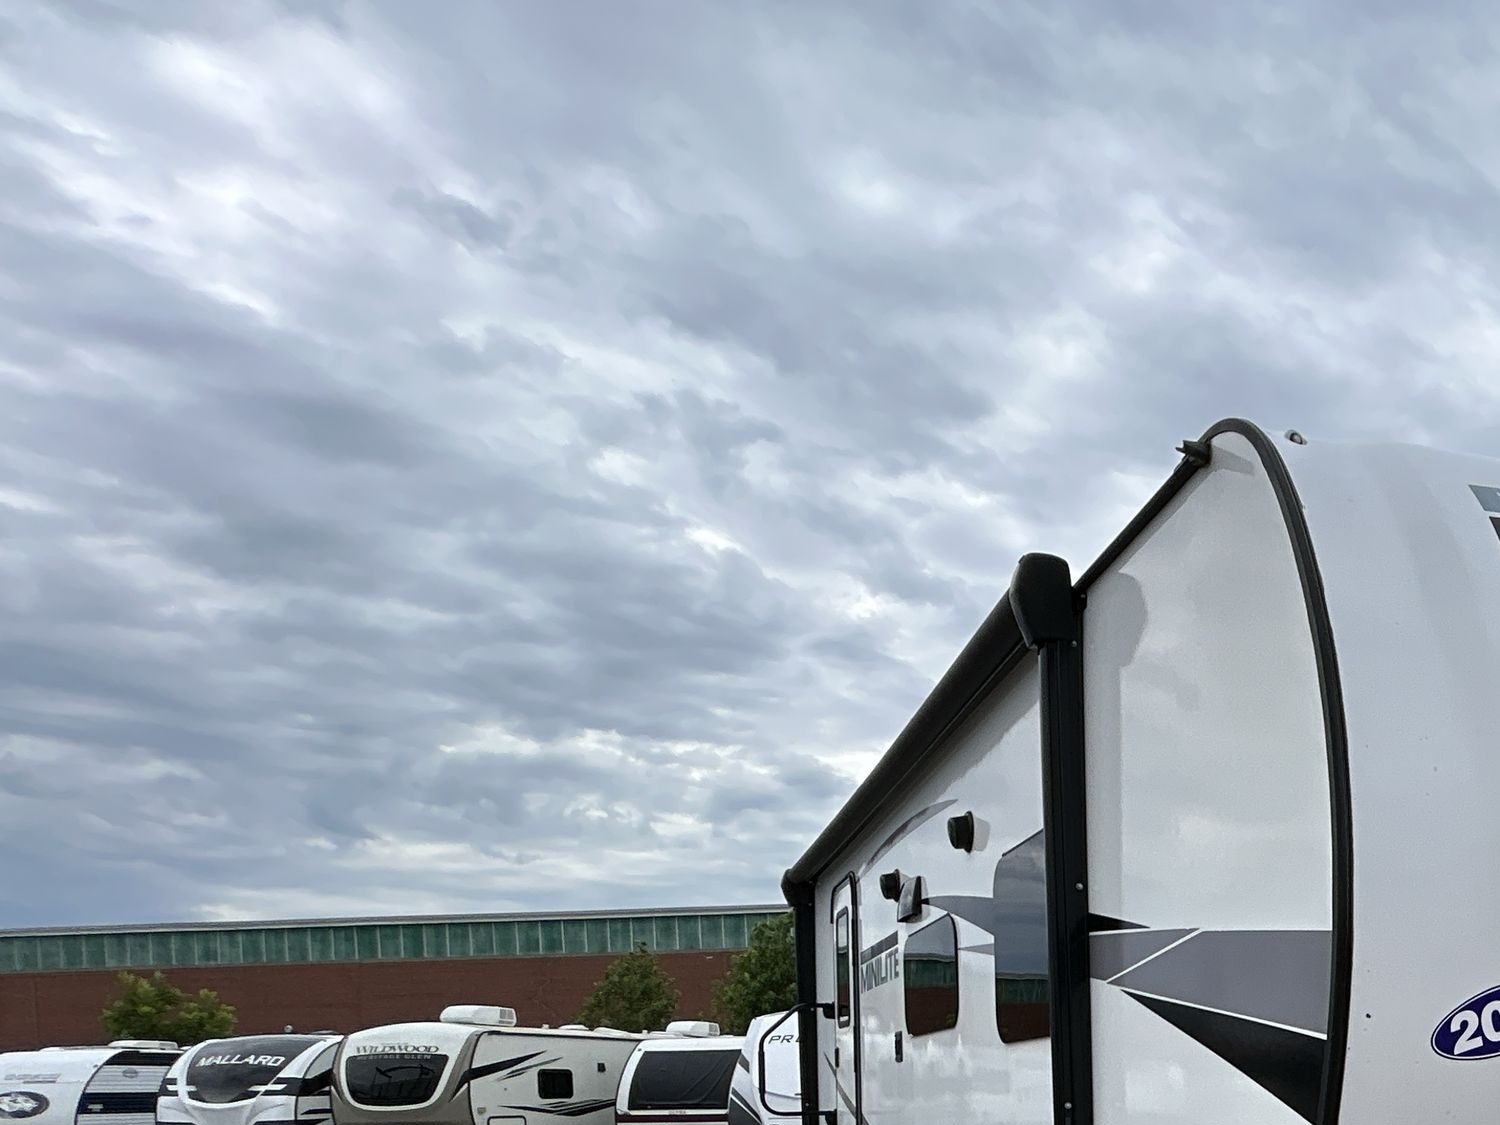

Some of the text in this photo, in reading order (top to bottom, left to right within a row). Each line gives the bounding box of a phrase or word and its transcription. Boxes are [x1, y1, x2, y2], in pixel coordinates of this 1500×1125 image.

[768, 1034, 800, 1044] PR
[355, 1045, 440, 1054] WILDWOOD
[195, 1054, 286, 1067] MALLARD
